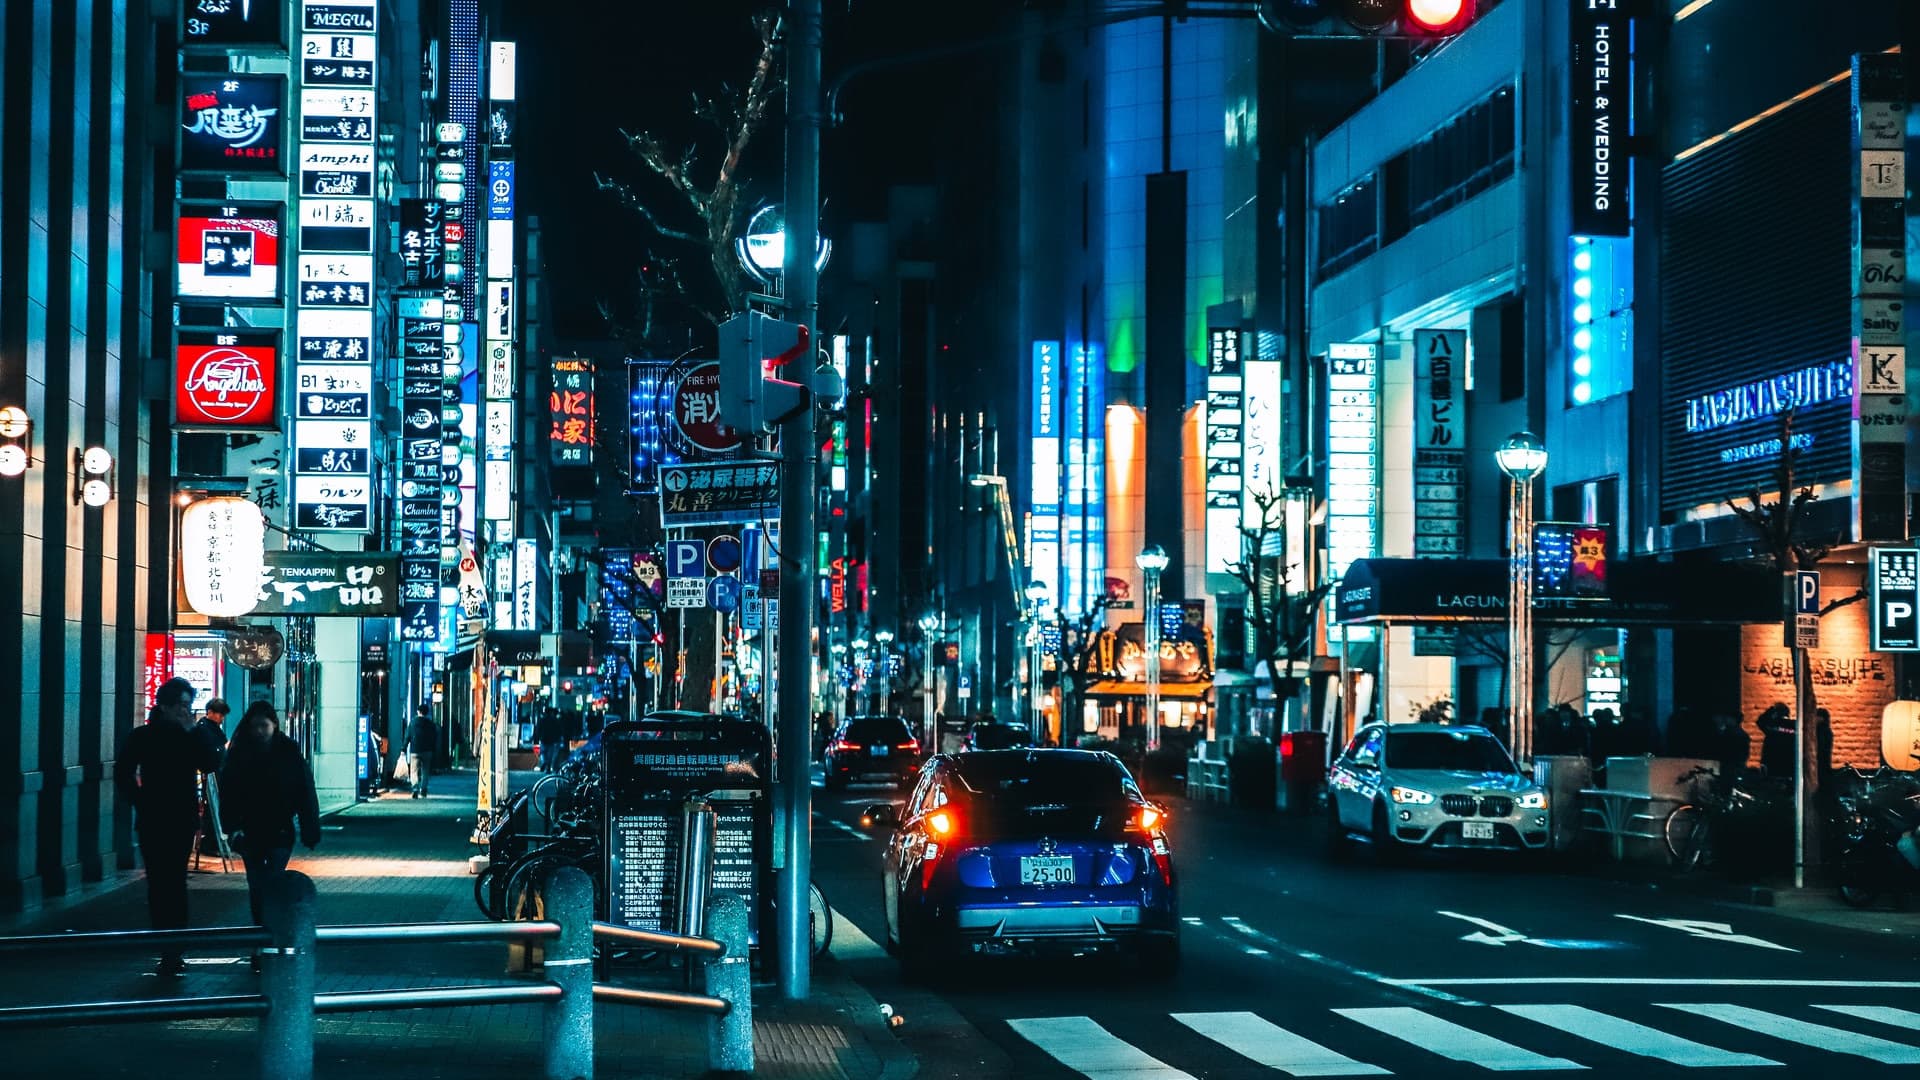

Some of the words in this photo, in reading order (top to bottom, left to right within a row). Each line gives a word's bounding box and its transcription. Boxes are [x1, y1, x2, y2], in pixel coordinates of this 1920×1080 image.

[187, 18, 209, 35] 3F
[313, 14, 364, 27] MEGU
[306, 41, 321, 55] 2F
[1595, 25, 1609, 91] HOTEL
[223, 81, 239, 92] 2F
[1595, 96, 1609, 110] &
[306, 153, 369, 165] Amphi
[1595, 115, 1609, 211] WEDDING
[222, 207, 238, 217] 1F
[423, 202, 441, 279] サンホテル
[403, 230, 421, 286] 名古屋
[304, 264, 320, 278] 1F
[1863, 318, 1900, 332] Salty
[301, 374, 317, 388] B1
[687, 375, 704, 385] FIRE
[690, 467, 776, 489] 泌尿器科
[677, 545, 698, 574] P
[281, 567, 336, 577] TENKAIPPIN
[832, 557, 845, 613] WELLA
[1802, 575, 1816, 610] P
[1886, 602, 1912, 628] P
[1032, 867, 1072, 882] 25-00
